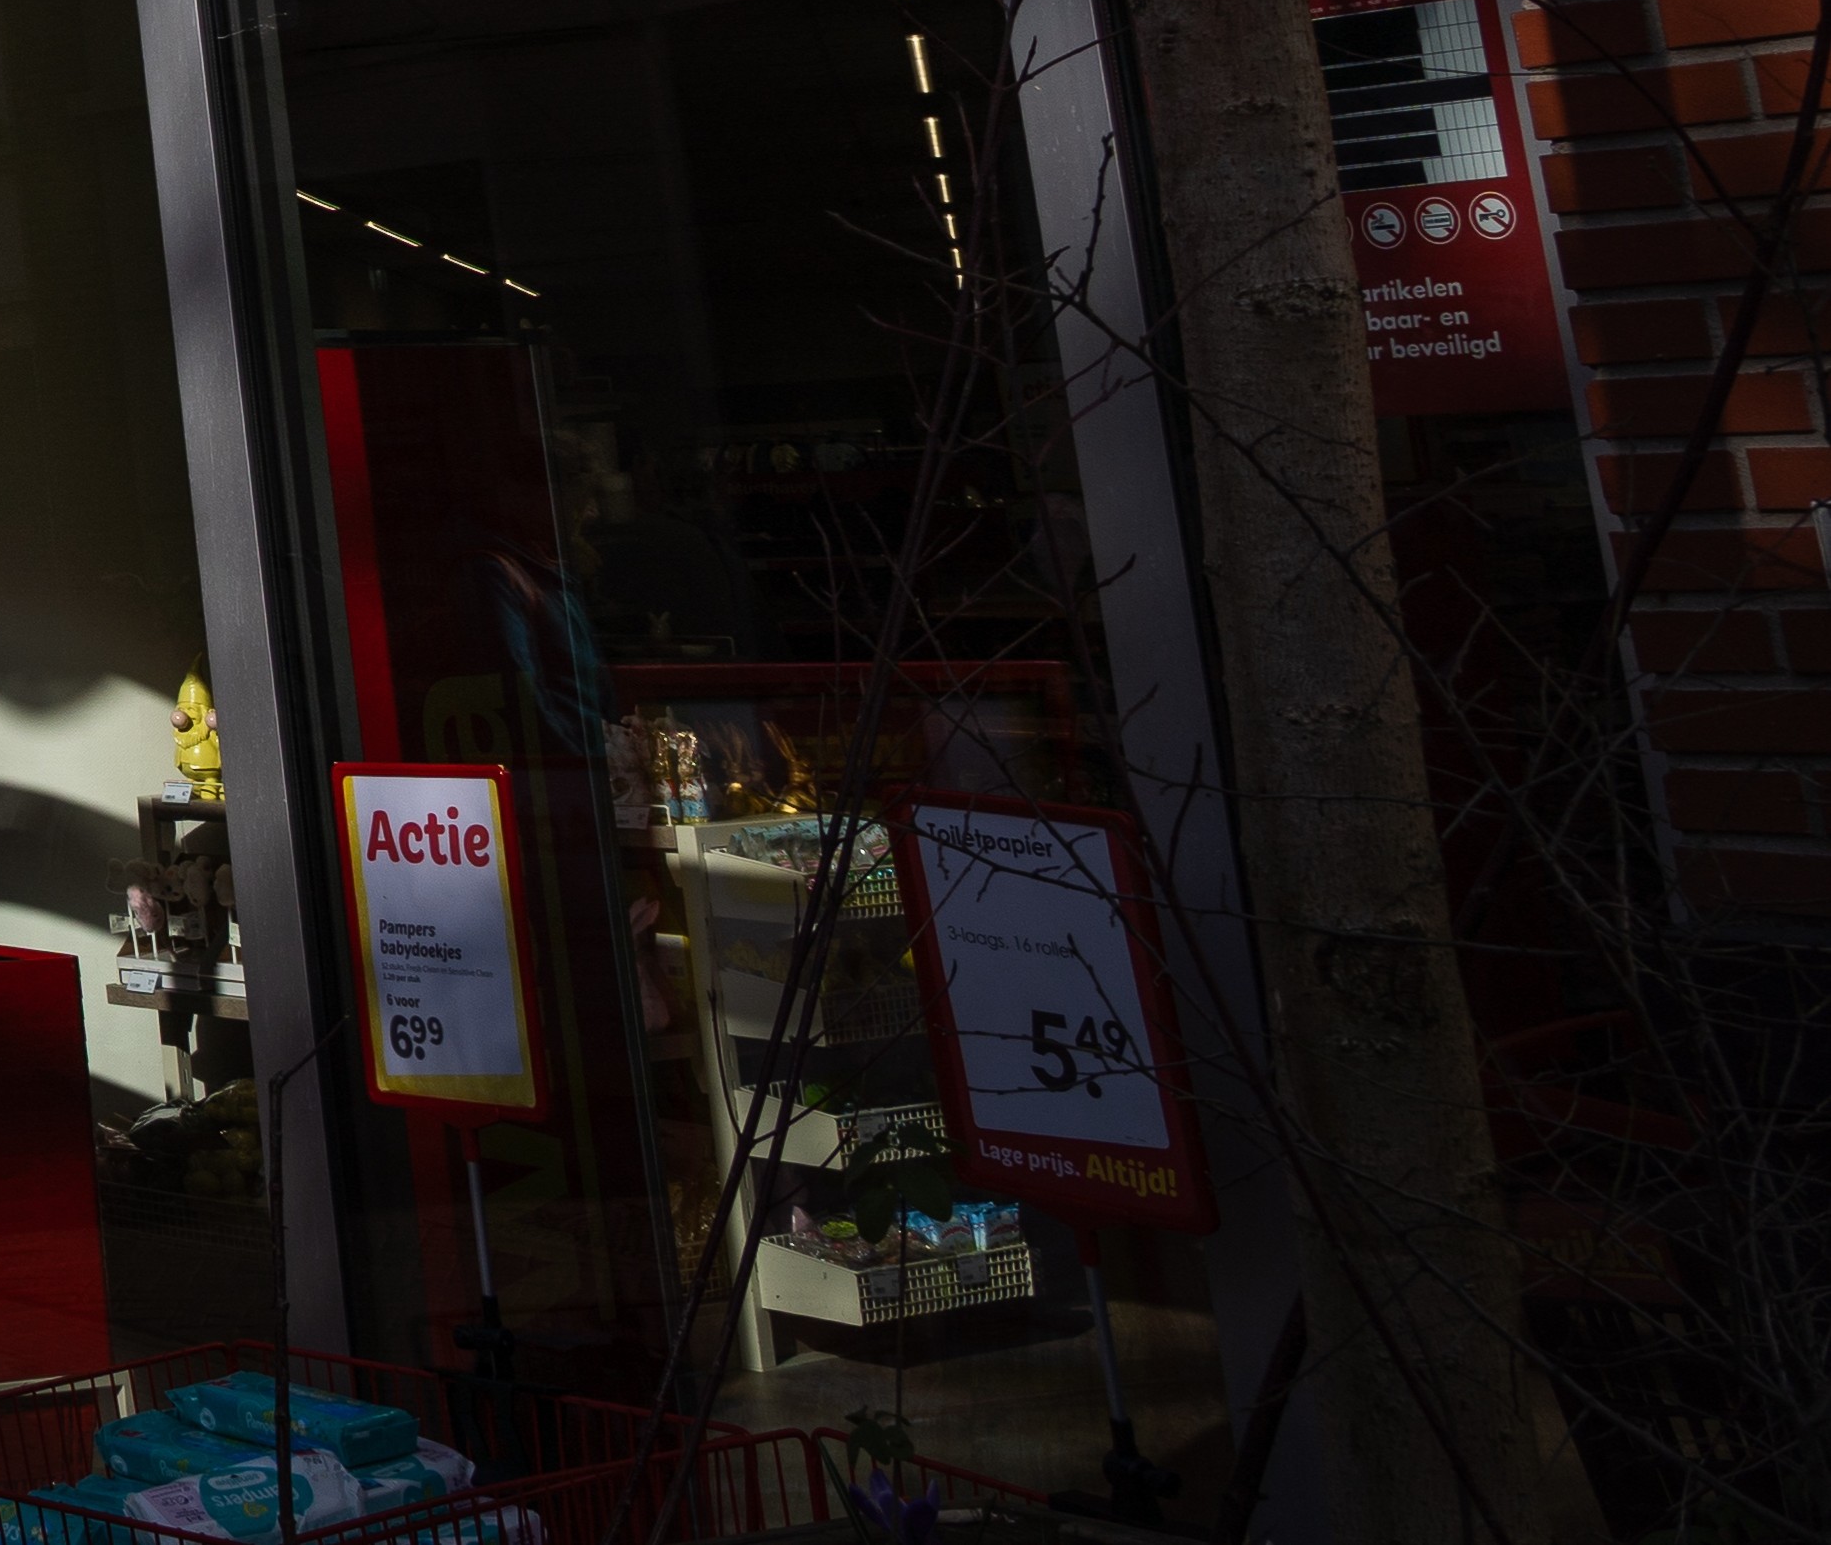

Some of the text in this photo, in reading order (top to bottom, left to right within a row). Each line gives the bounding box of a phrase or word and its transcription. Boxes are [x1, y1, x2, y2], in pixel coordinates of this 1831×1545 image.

[1365, 310, 1470, 331] baar- en
[1390, 330, 1502, 360] beveiligd
[366, 806, 490, 867] Actie
[927, 821, 1053, 857] Toiletpapier
[379, 919, 436, 938] Pampers
[1014, 935, 1031, 952] 16
[380, 940, 462, 962] babydoekjes
[386, 994, 420, 1008] 6 voor
[390, 1014, 443, 1060] 6.99
[1031, 1009, 1128, 1098] 5.49
[978, 1139, 1178, 1198] Lage prijs. Altijd!
